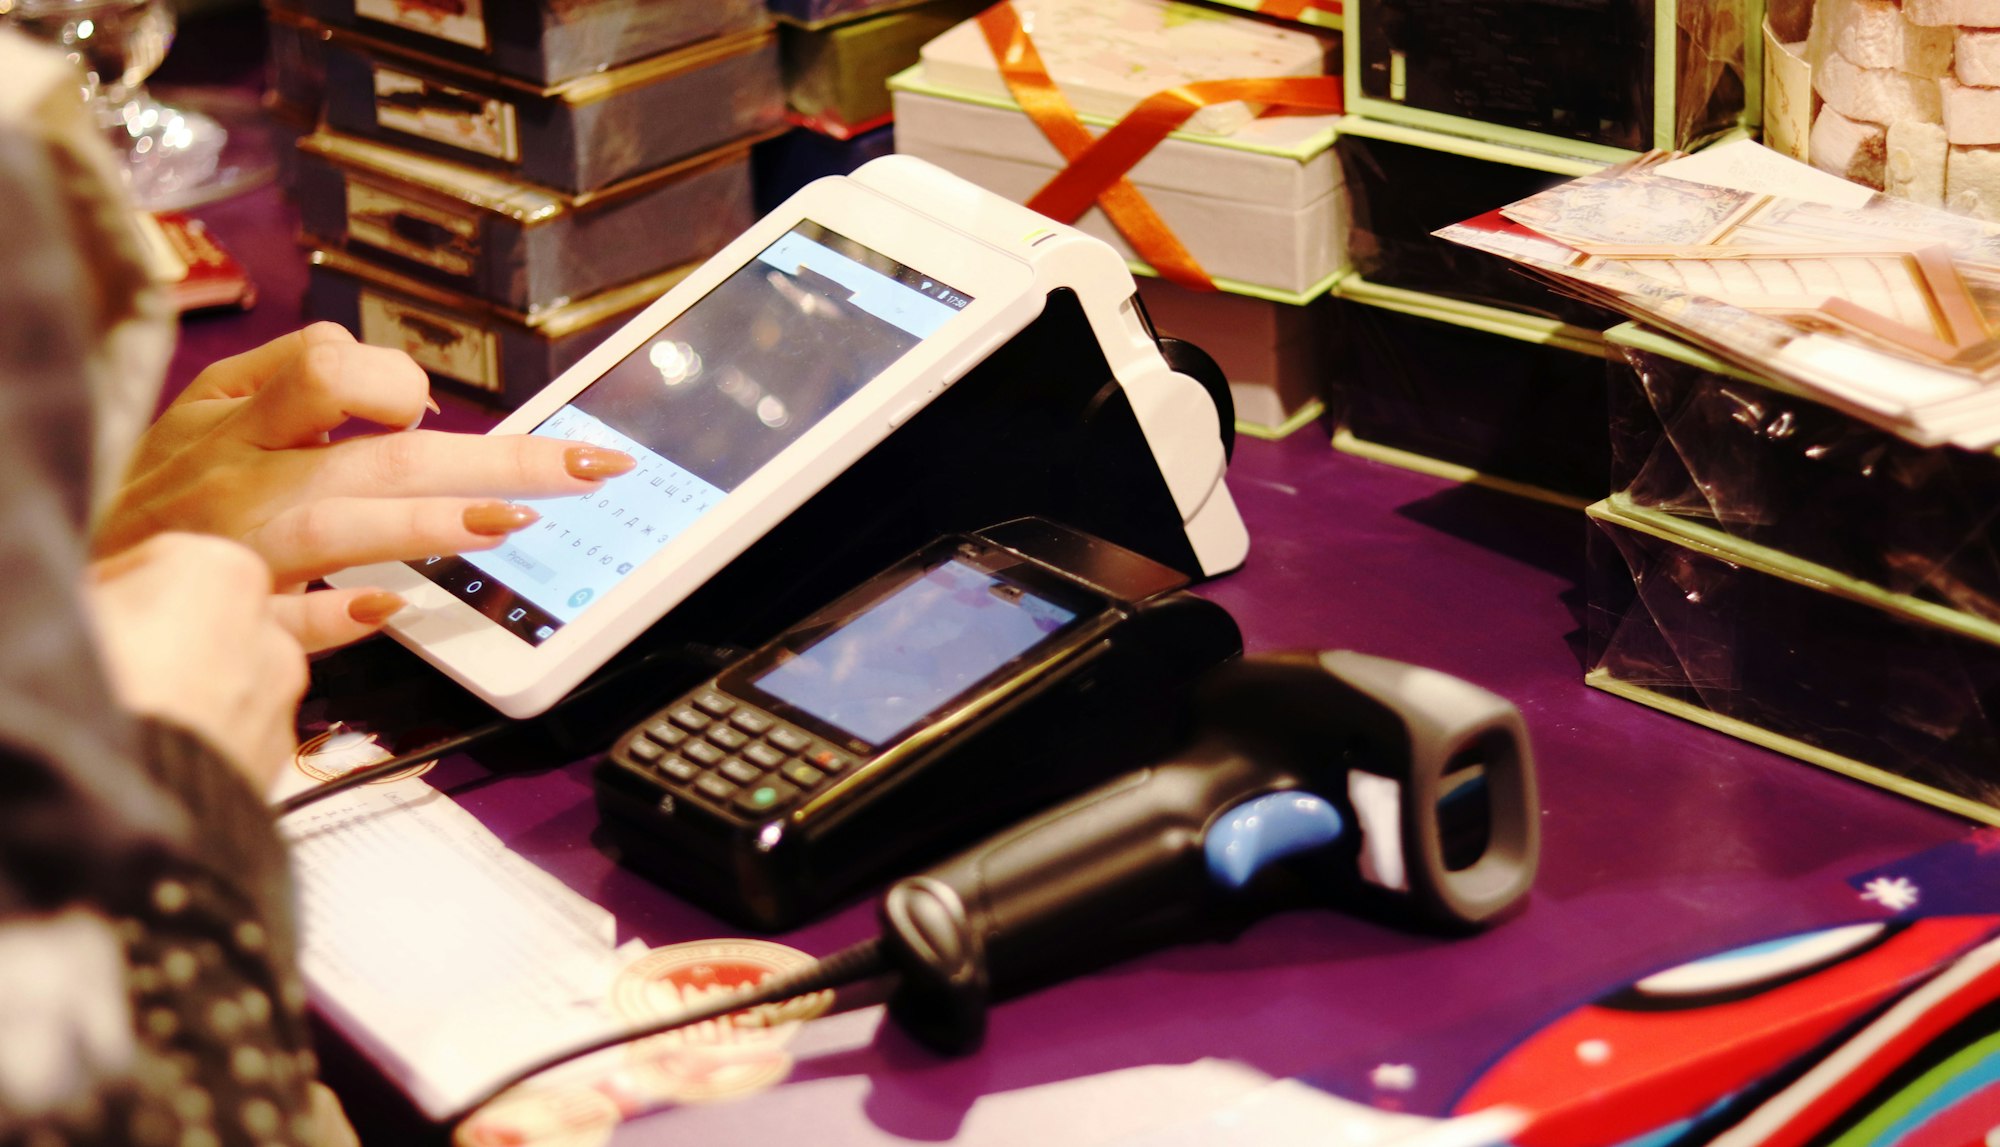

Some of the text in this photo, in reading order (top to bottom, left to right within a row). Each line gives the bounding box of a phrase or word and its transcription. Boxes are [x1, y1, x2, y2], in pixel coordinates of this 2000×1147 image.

[946, 295, 967, 308] 17:50
[636, 469, 648, 477] г
[650, 476, 665, 487] ш
[664, 485, 679, 498] щ
[611, 508, 624, 517] л
[623, 517, 639, 528] д
[559, 529, 571, 538] т
